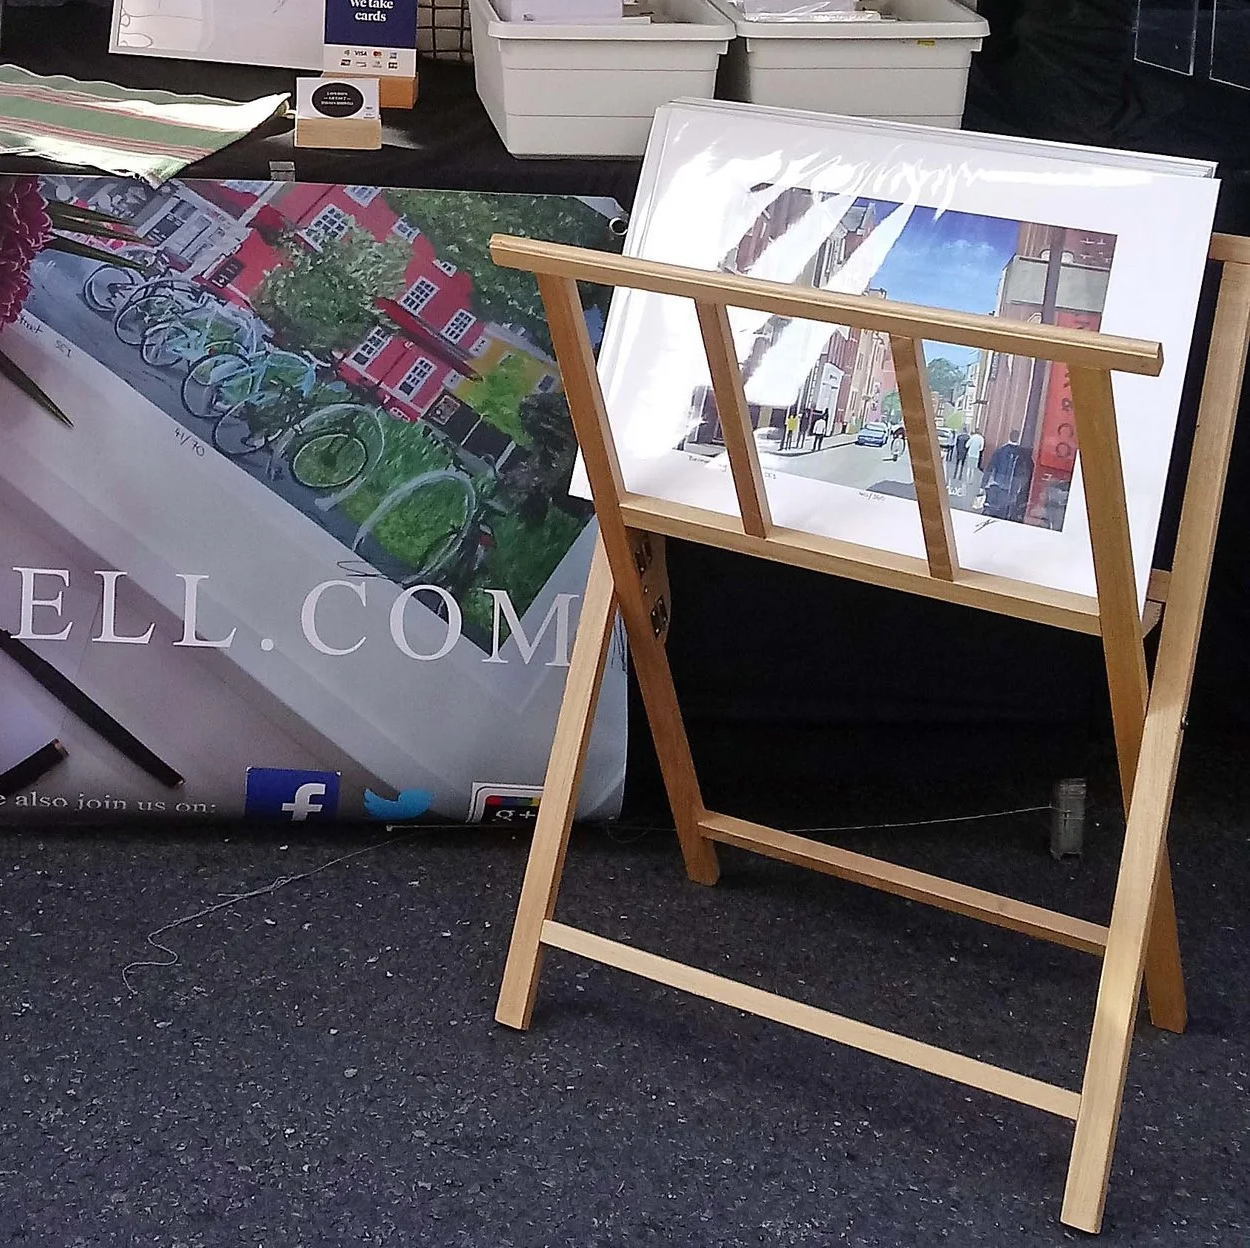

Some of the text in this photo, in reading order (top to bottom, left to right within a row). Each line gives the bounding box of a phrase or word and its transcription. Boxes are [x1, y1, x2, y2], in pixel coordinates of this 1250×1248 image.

[354, 10, 387, 22] cards
[15, 791, 69, 809] also
[75, 793, 127, 811] join
[138, 801, 167, 812] us
[175, 802, 218, 814] on:
